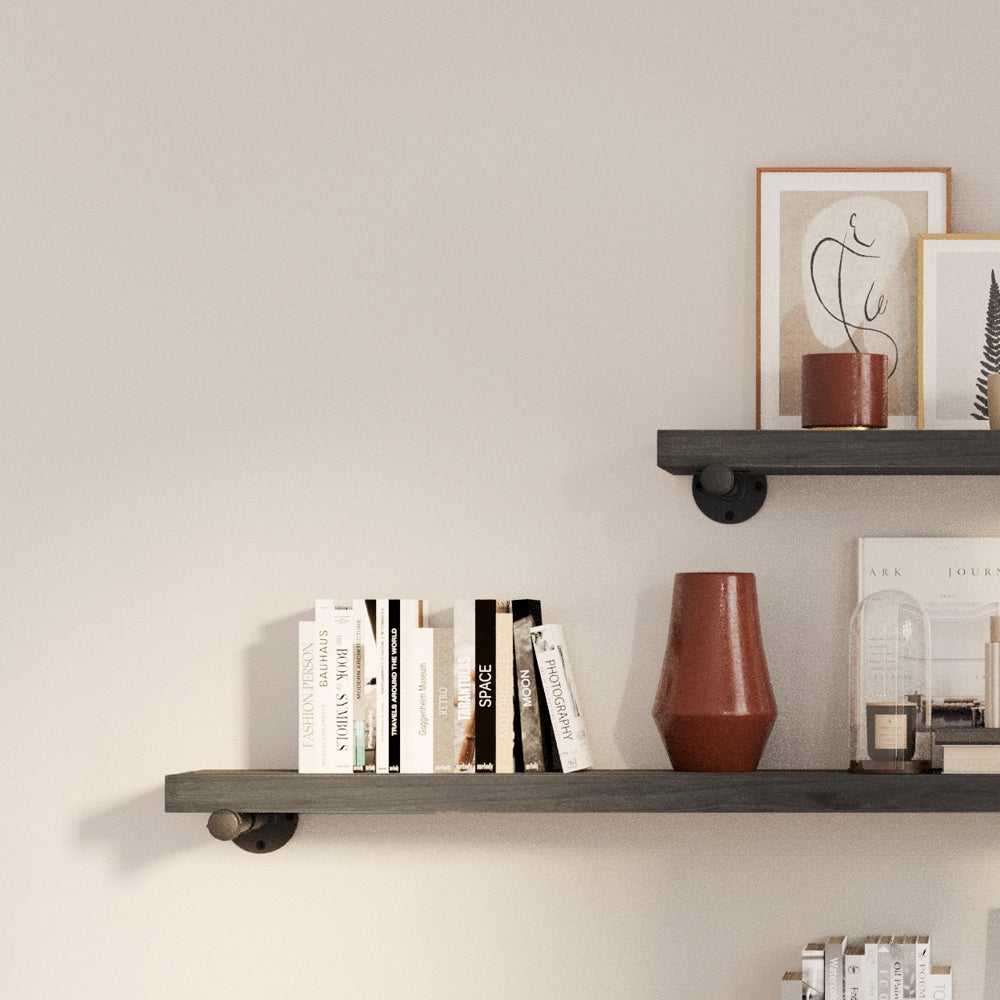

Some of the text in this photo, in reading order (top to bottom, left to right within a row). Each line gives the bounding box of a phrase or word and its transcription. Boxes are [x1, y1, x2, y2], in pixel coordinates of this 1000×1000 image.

[869, 568, 903, 577] ARK
[319, 630, 328, 688] BAUHAUS
[336, 648, 348, 681] BOOK
[302, 642, 314, 748] FASHION PERSON
[418, 663, 429, 736] Guggenheim Museum
[438, 687, 448, 715] RETRO
[457, 656, 471, 720] TARANTULAS
[478, 664, 492, 708] SPACE
[520, 669, 533, 708] MOON
[545, 659, 574, 741] PHOTOGRAPHY
[336, 694, 348, 751] SYMBOLS
[893, 961, 901, 976] Oil
